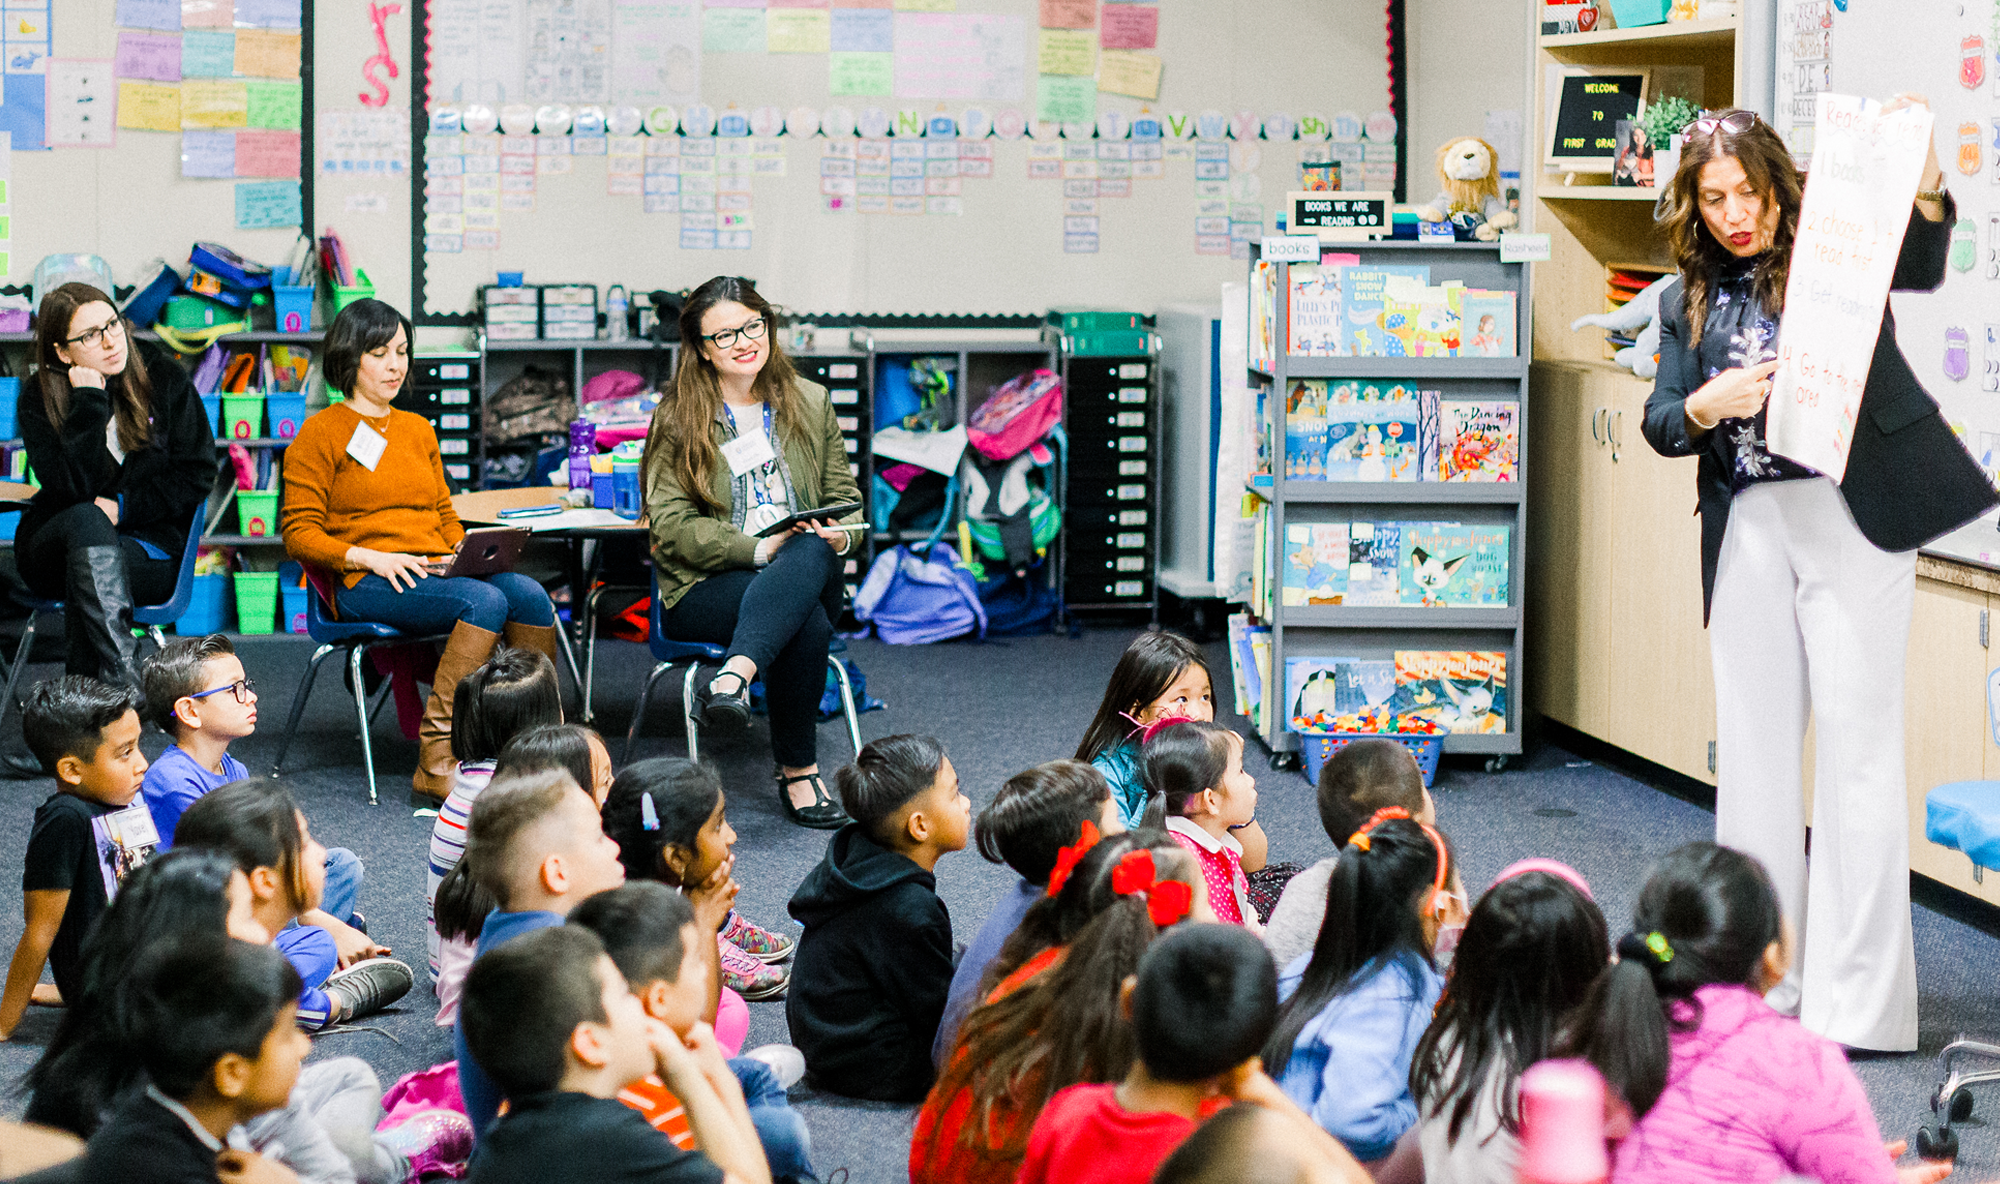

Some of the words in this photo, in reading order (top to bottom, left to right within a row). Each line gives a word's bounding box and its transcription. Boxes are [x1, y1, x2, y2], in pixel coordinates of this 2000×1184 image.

[1584, 83, 1620, 94] WELCOME
[650, 106, 673, 134] G
[899, 110, 918, 135] N
[1592, 110, 1605, 121] TO
[1168, 114, 1187, 138] V
[1563, 138, 1586, 149] FIRST
[1595, 138, 1617, 149] GRAD
[1304, 201, 1332, 212] BOOKS
[1334, 201, 1348, 212] WE
[1352, 201, 1370, 212] ARE
[1269, 241, 1311, 256] books
[1503, 242, 1549, 256] Rasheed
[1800, 352, 1816, 379] Go
[1459, 420, 1502, 439] Dragon
